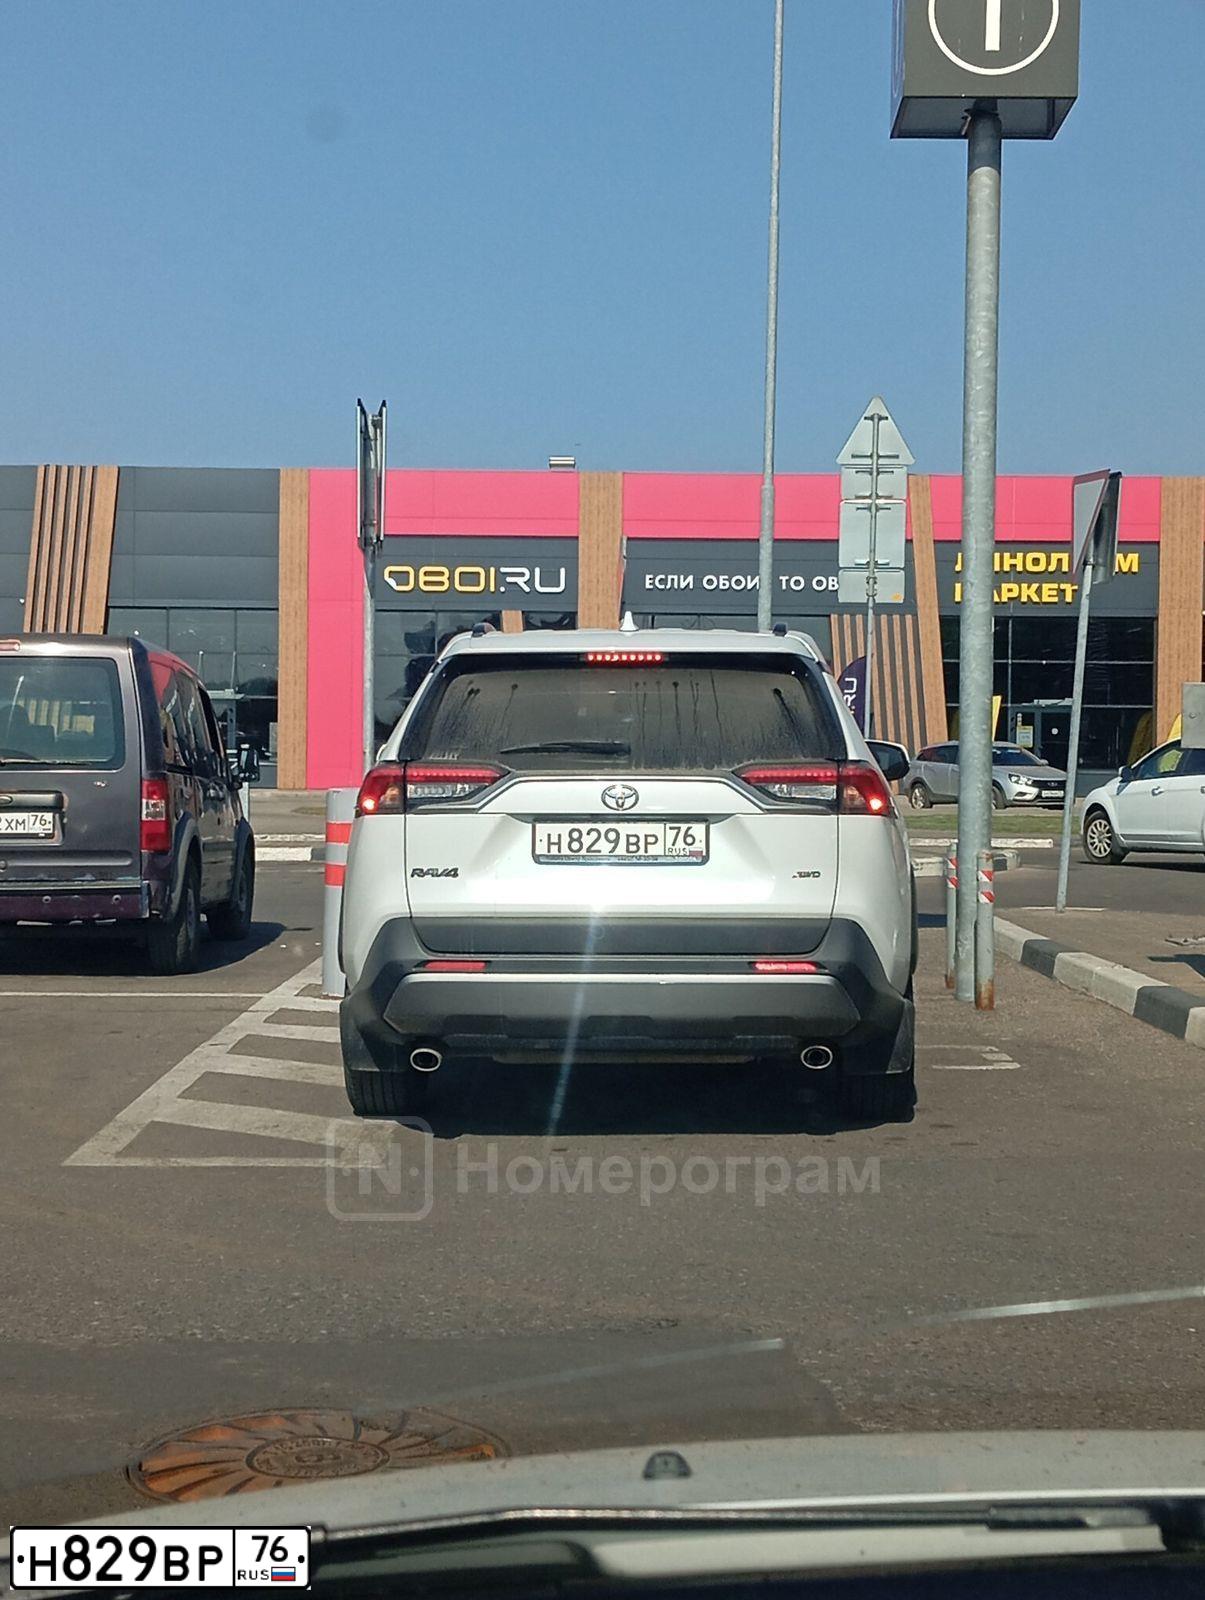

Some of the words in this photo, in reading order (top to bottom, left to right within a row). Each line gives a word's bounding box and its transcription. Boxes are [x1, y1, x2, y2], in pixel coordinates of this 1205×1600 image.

[383, 565, 566, 593] OBOI.RU
[645, 574, 694, 590] ЕСЛИ
[702, 574, 760, 590] ОБОИ
[779, 575, 805, 591] ТО
[955, 583, 1078, 603] РКЕТ
[844, 678, 858, 714] .RU
[0, 815, 26, 831] ХМ
[31, 814, 47, 827] 76
[547, 827, 659, 854] Н829ВР
[668, 826, 696, 847] 76
[667, 848, 688, 856] RUS
[410, 867, 459, 878] RAV4
